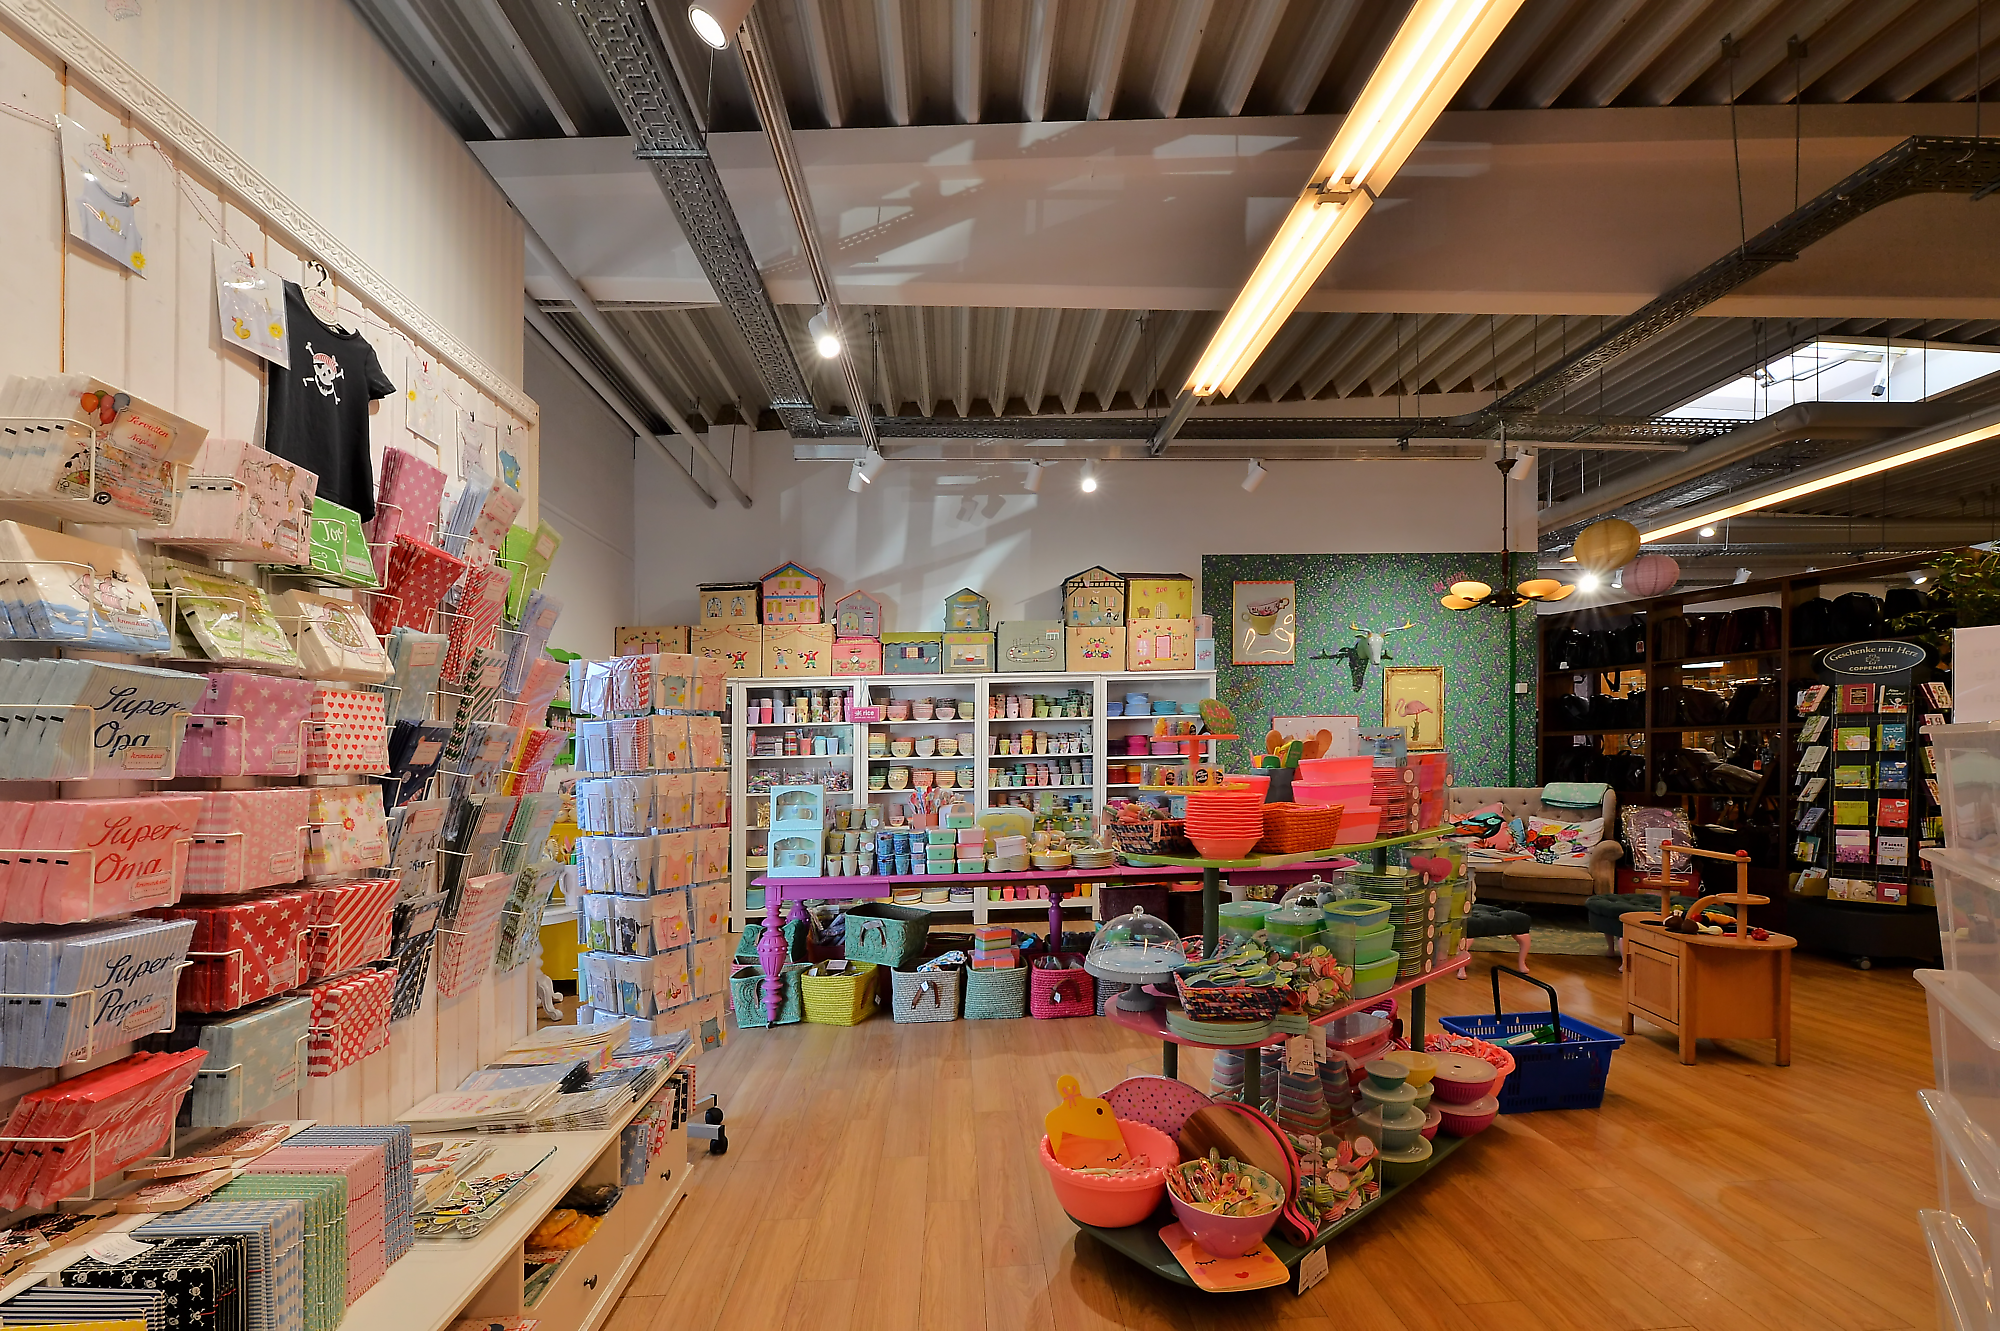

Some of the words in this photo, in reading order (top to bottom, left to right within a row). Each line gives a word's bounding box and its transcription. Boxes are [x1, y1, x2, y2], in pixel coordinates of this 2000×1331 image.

[128, 433, 158, 450] Napkins
[318, 520, 344, 542] Tor
[1829, 646, 1876, 661] Geschenke
[1878, 645, 1894, 653] mit
[1896, 646, 1919, 658] Herz
[1848, 664, 1897, 672] COPPENRATH
[94, 720, 151, 758] Opa
[94, 852, 162, 884] Oma
